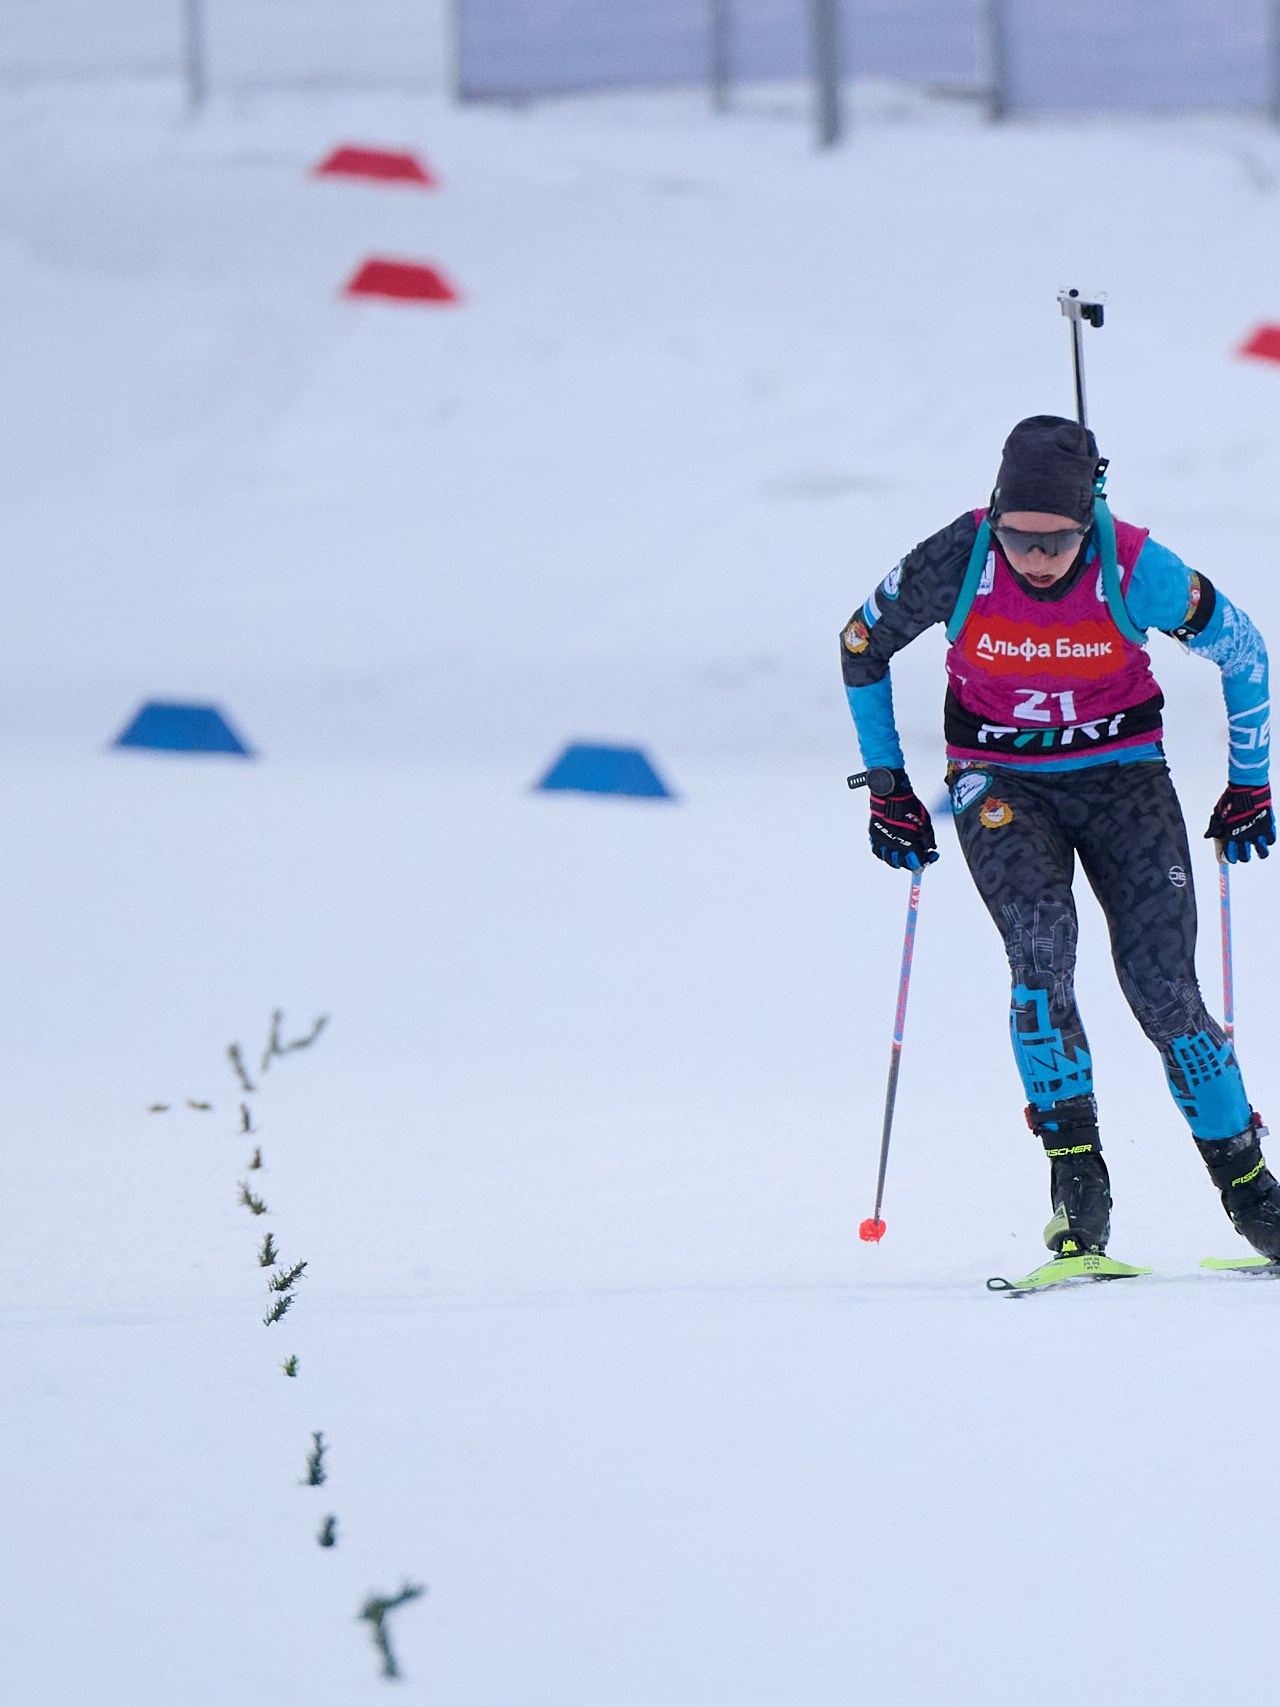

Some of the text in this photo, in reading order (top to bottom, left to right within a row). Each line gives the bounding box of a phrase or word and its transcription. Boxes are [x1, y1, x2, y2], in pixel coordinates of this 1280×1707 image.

[976, 632, 1113, 661] Альфа Банк
[1012, 688, 1078, 723] 21
